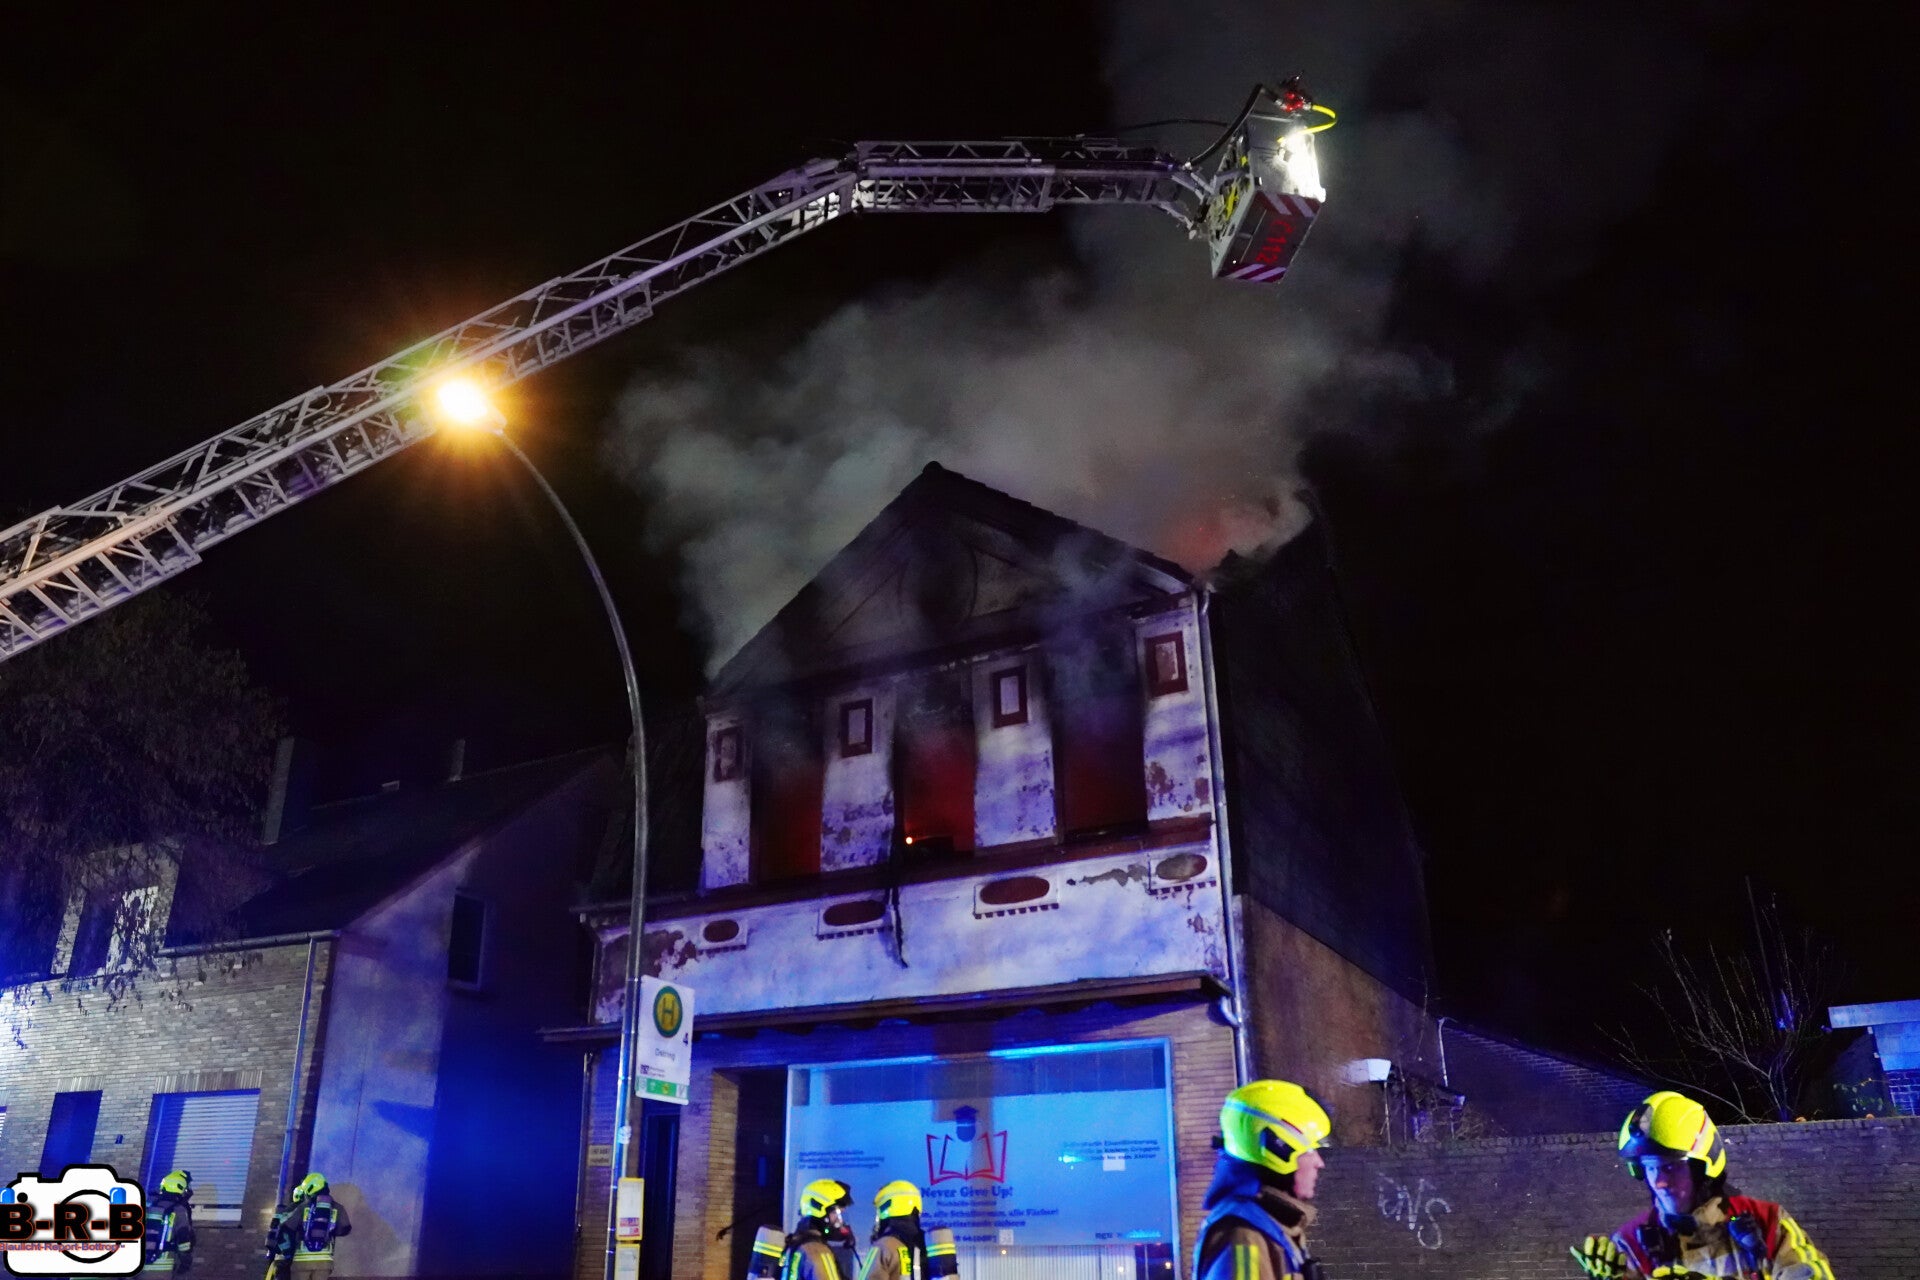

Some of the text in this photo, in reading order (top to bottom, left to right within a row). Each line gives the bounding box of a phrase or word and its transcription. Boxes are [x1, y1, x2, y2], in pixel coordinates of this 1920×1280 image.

[662, 998, 675, 1026] H
[921, 1186, 1013, 1199] Never Give Up!
